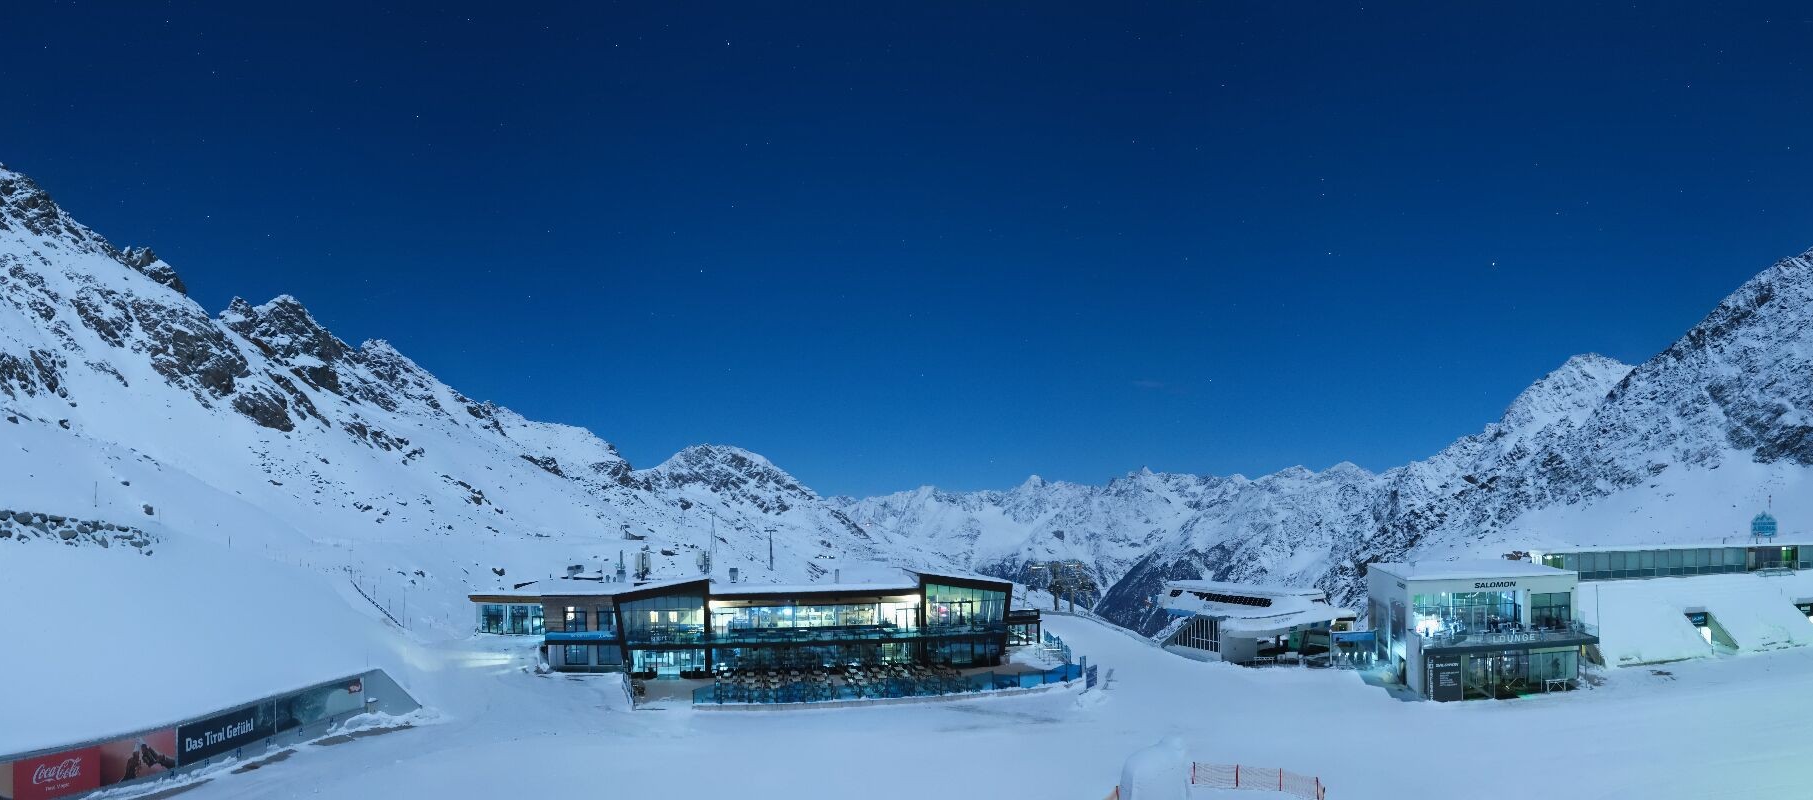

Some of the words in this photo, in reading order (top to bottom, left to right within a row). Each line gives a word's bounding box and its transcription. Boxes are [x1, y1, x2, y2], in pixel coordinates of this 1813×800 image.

[1474, 581, 1517, 589] SALOMON
[1492, 633, 1536, 643] LOUNGE
[185, 737, 204, 753] Das
[204, 726, 226, 746] Tirol
[226, 717, 254, 739] Gefühl
[32, 757, 81, 784] Coca-Cola
